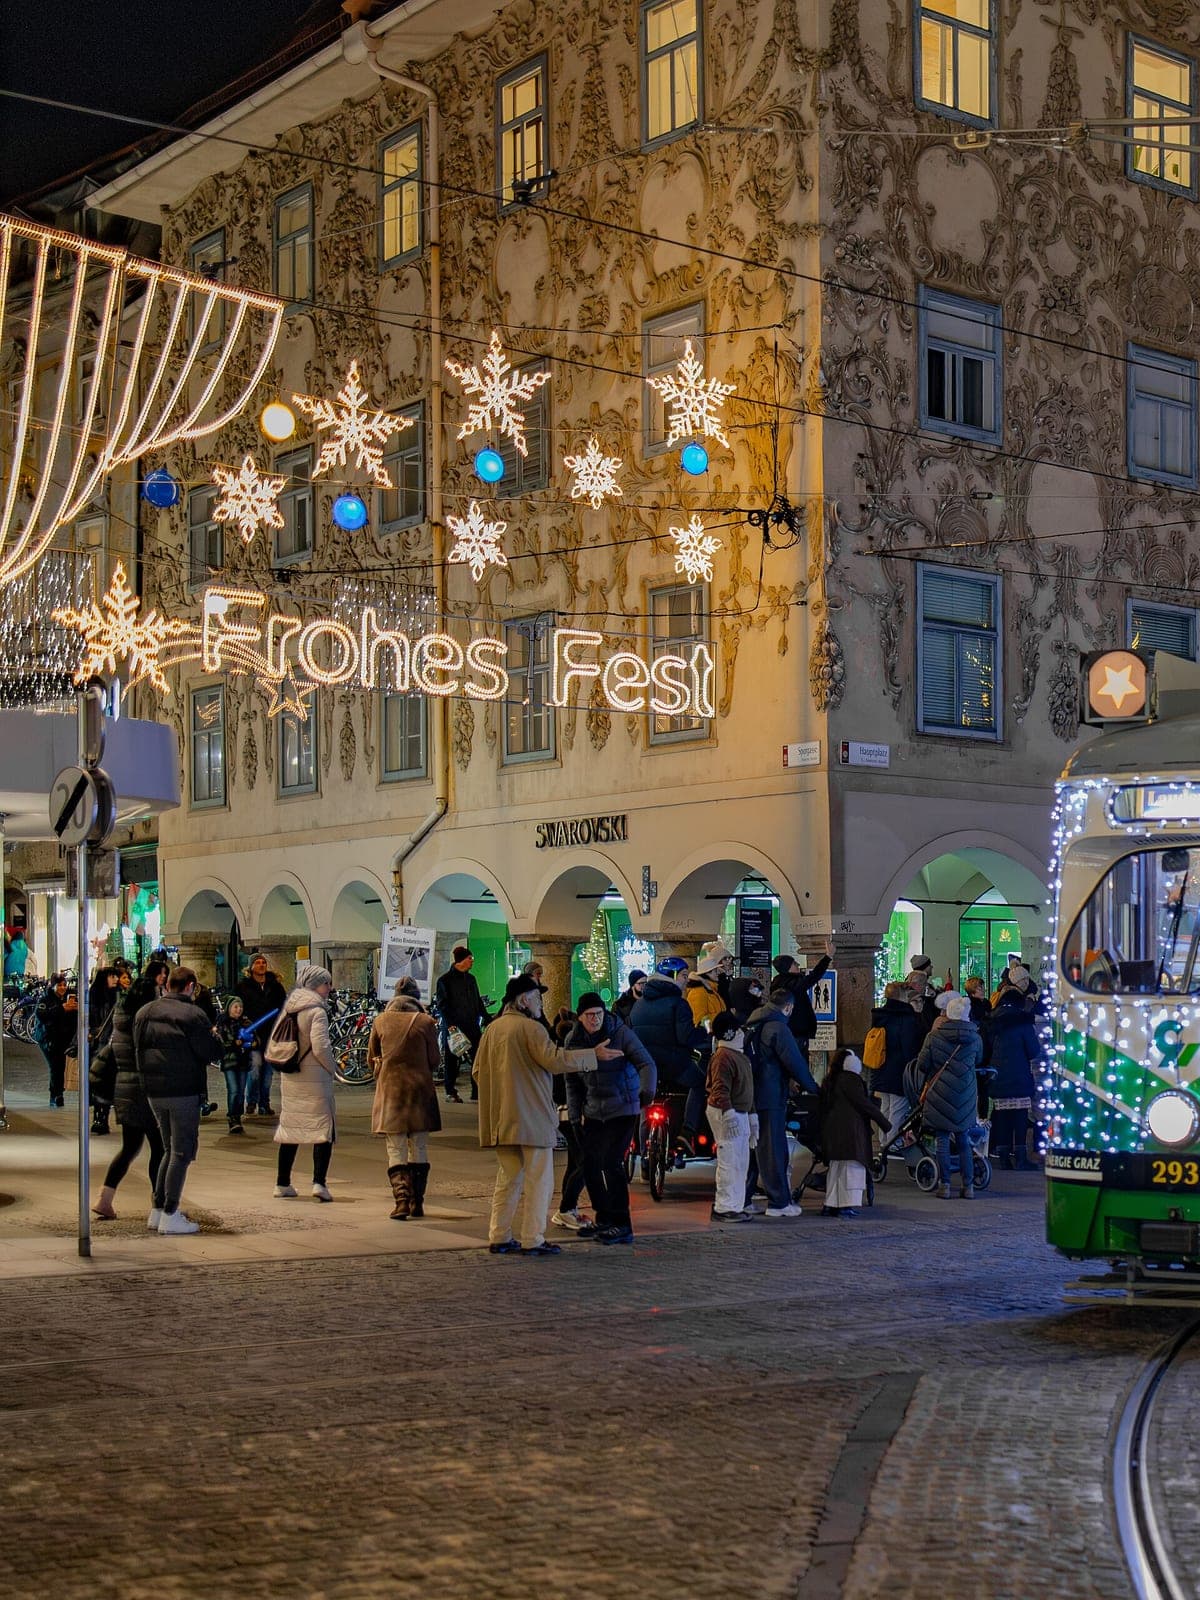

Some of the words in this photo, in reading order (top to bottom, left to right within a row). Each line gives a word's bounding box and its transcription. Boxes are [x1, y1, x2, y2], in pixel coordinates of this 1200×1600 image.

[201, 585, 510, 700] Frohes
[552, 628, 715, 718] Fest
[859, 746, 888, 758] Hauptplatz
[535, 814, 629, 849] SWAROVSKI
[1073, 1156, 1101, 1170] GRAZ
[1151, 1160, 1200, 1185] 293
